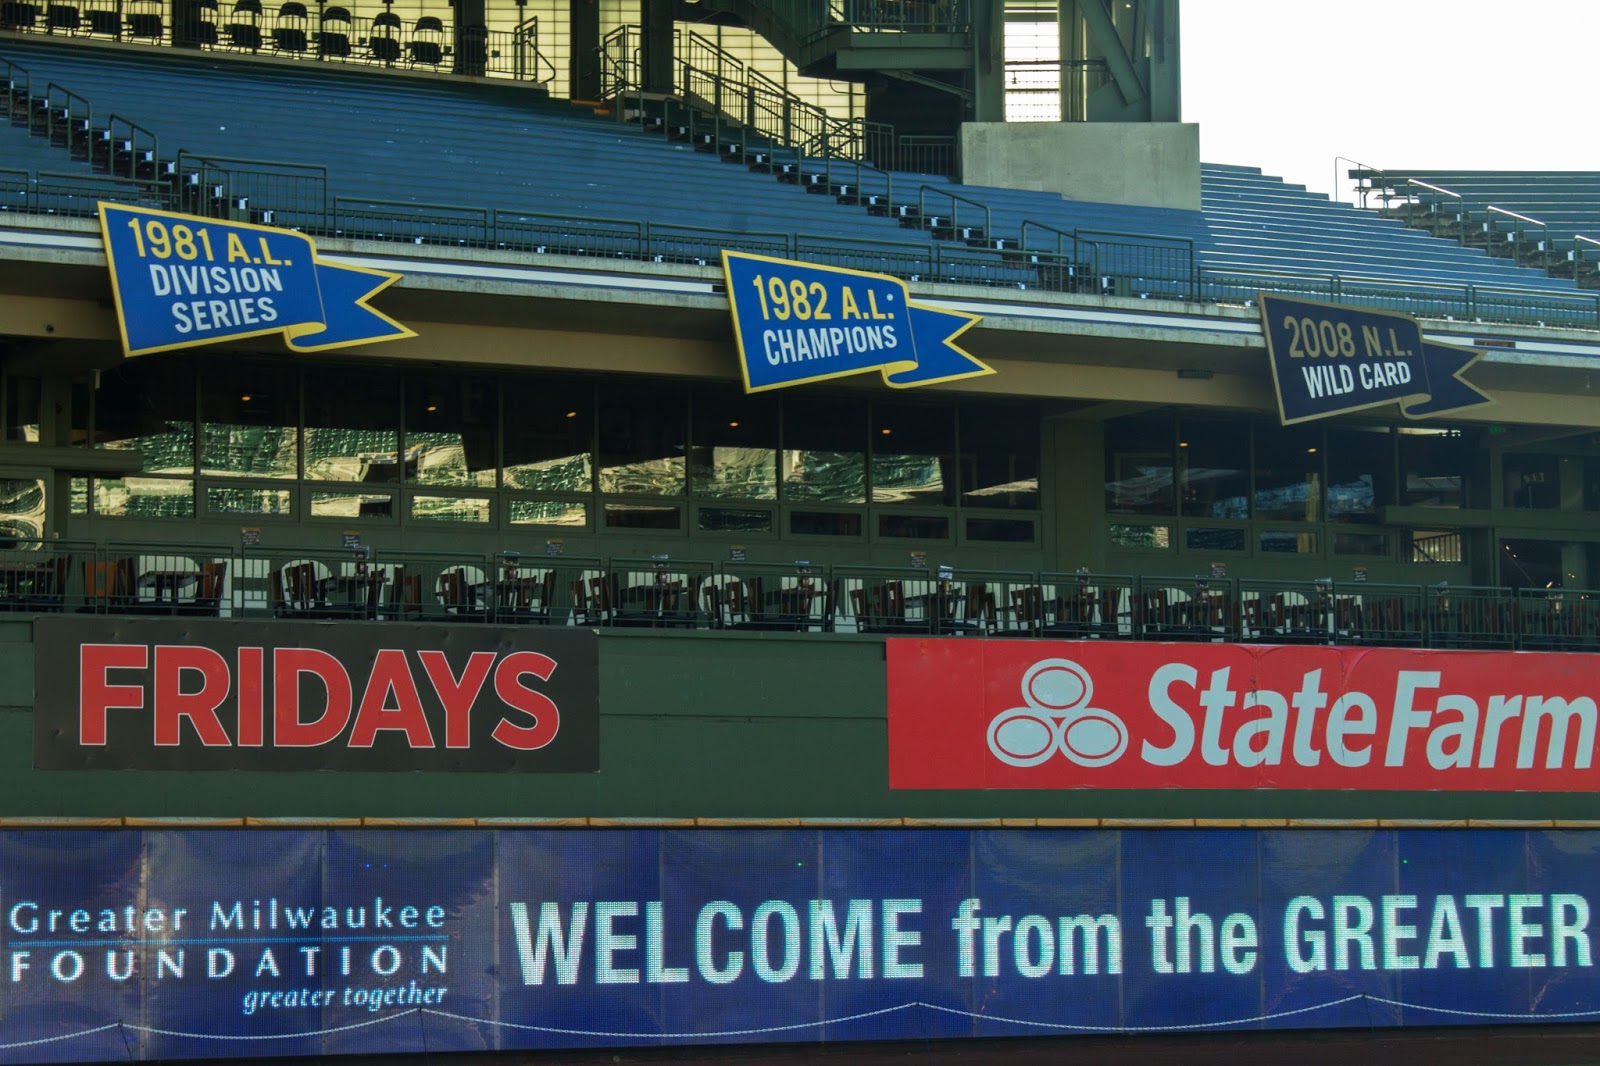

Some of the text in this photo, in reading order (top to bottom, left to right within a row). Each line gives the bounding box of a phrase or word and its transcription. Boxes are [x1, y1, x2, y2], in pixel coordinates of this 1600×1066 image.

[128, 217, 292, 266] 1981 A.L.
[149, 264, 283, 296] DIVISION
[753, 274, 895, 320] 1982 A.L.
[171, 297, 278, 334] SERIES
[763, 325, 898, 366] CHAMPIONS
[1284, 315, 1413, 358] 2008 N.L.
[1302, 361, 1411, 399] WILD CARD
[79, 643, 560, 750] FRIDAYS
[9, 897, 446, 933] Greater Milwaukee
[510, 893, 1594, 986] WELCOME from the GREATER
[11, 945, 448, 983] FOUNDATION
[242, 980, 448, 1015] greater together
